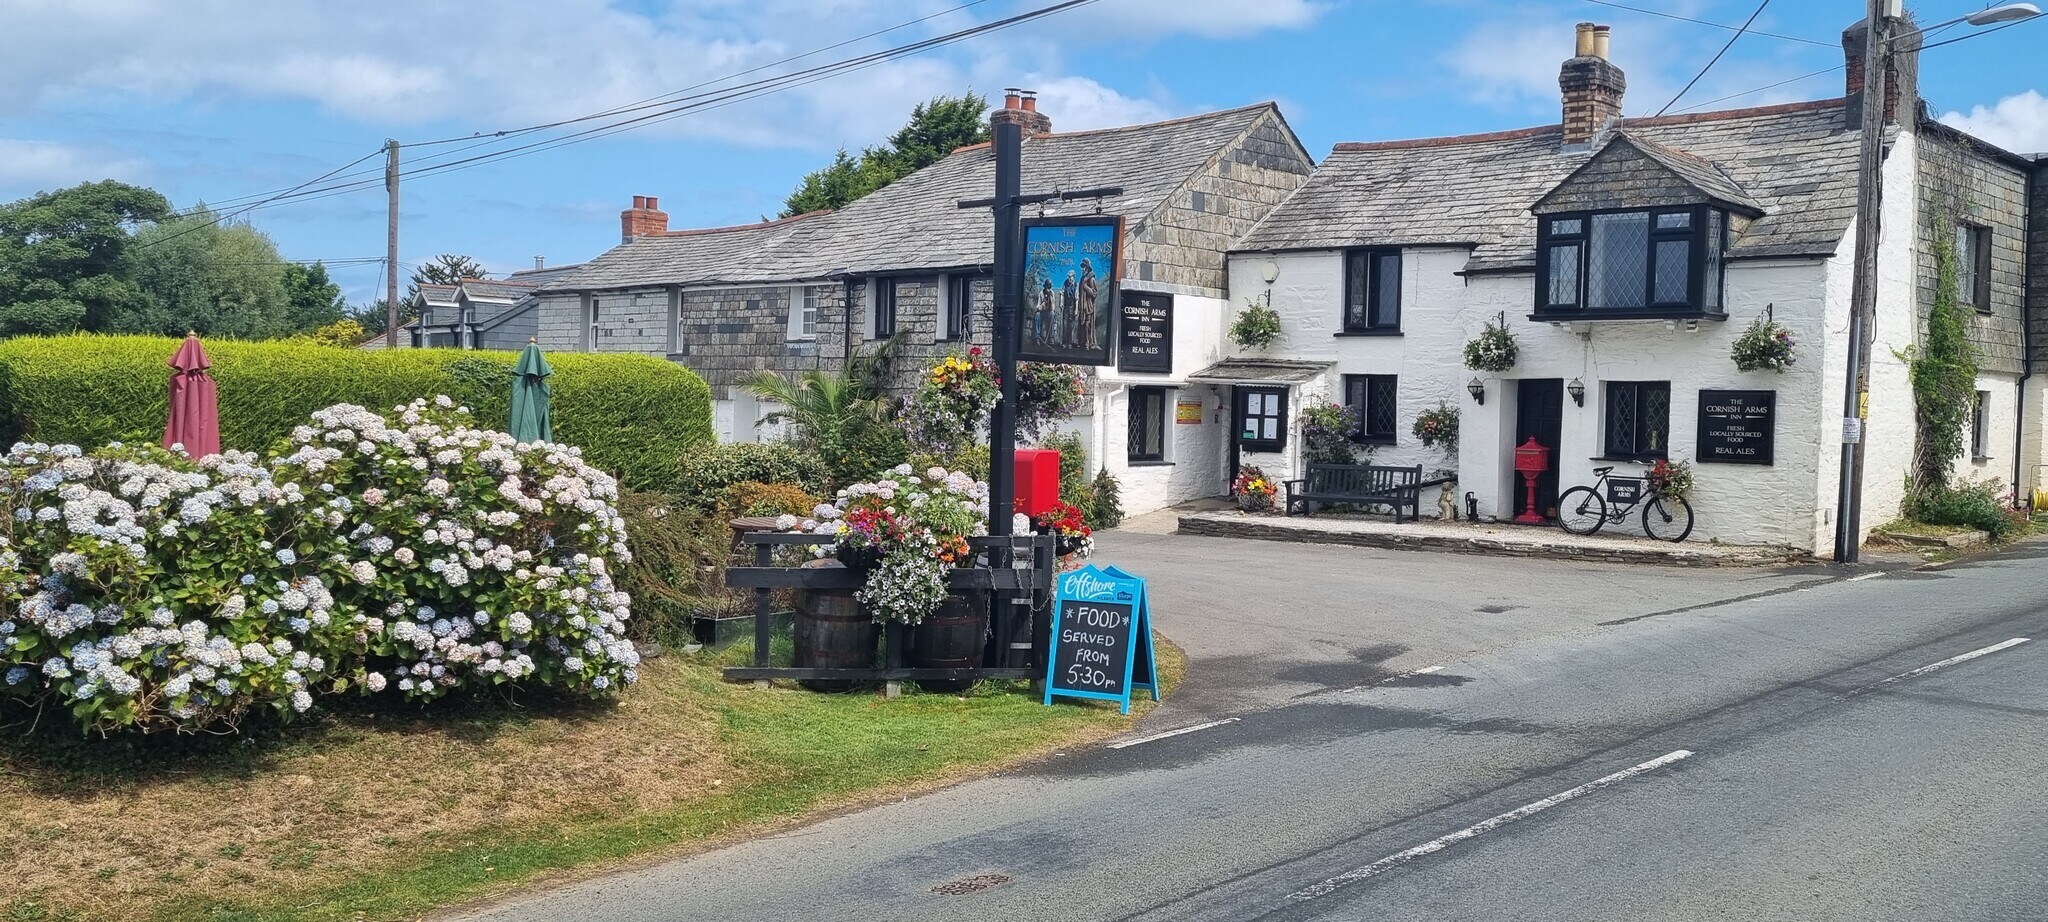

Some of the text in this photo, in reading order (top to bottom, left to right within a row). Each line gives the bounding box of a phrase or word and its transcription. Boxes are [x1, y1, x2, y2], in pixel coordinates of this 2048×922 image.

[1063, 228, 1076, 237] THE
[1027, 240, 1113, 254] CORNISH ARMS
[1124, 306, 1149, 315] CORNISH
[1132, 346, 1145, 354] REAL
[1706, 405, 1740, 413] CORNISH
[1613, 485, 1636, 493] CORNISH
[1064, 571, 1116, 599] Offshore
[1077, 606, 1121, 629] FOOD
[1062, 629, 1115, 647] SERVED
[1075, 648, 1110, 667] FROM
